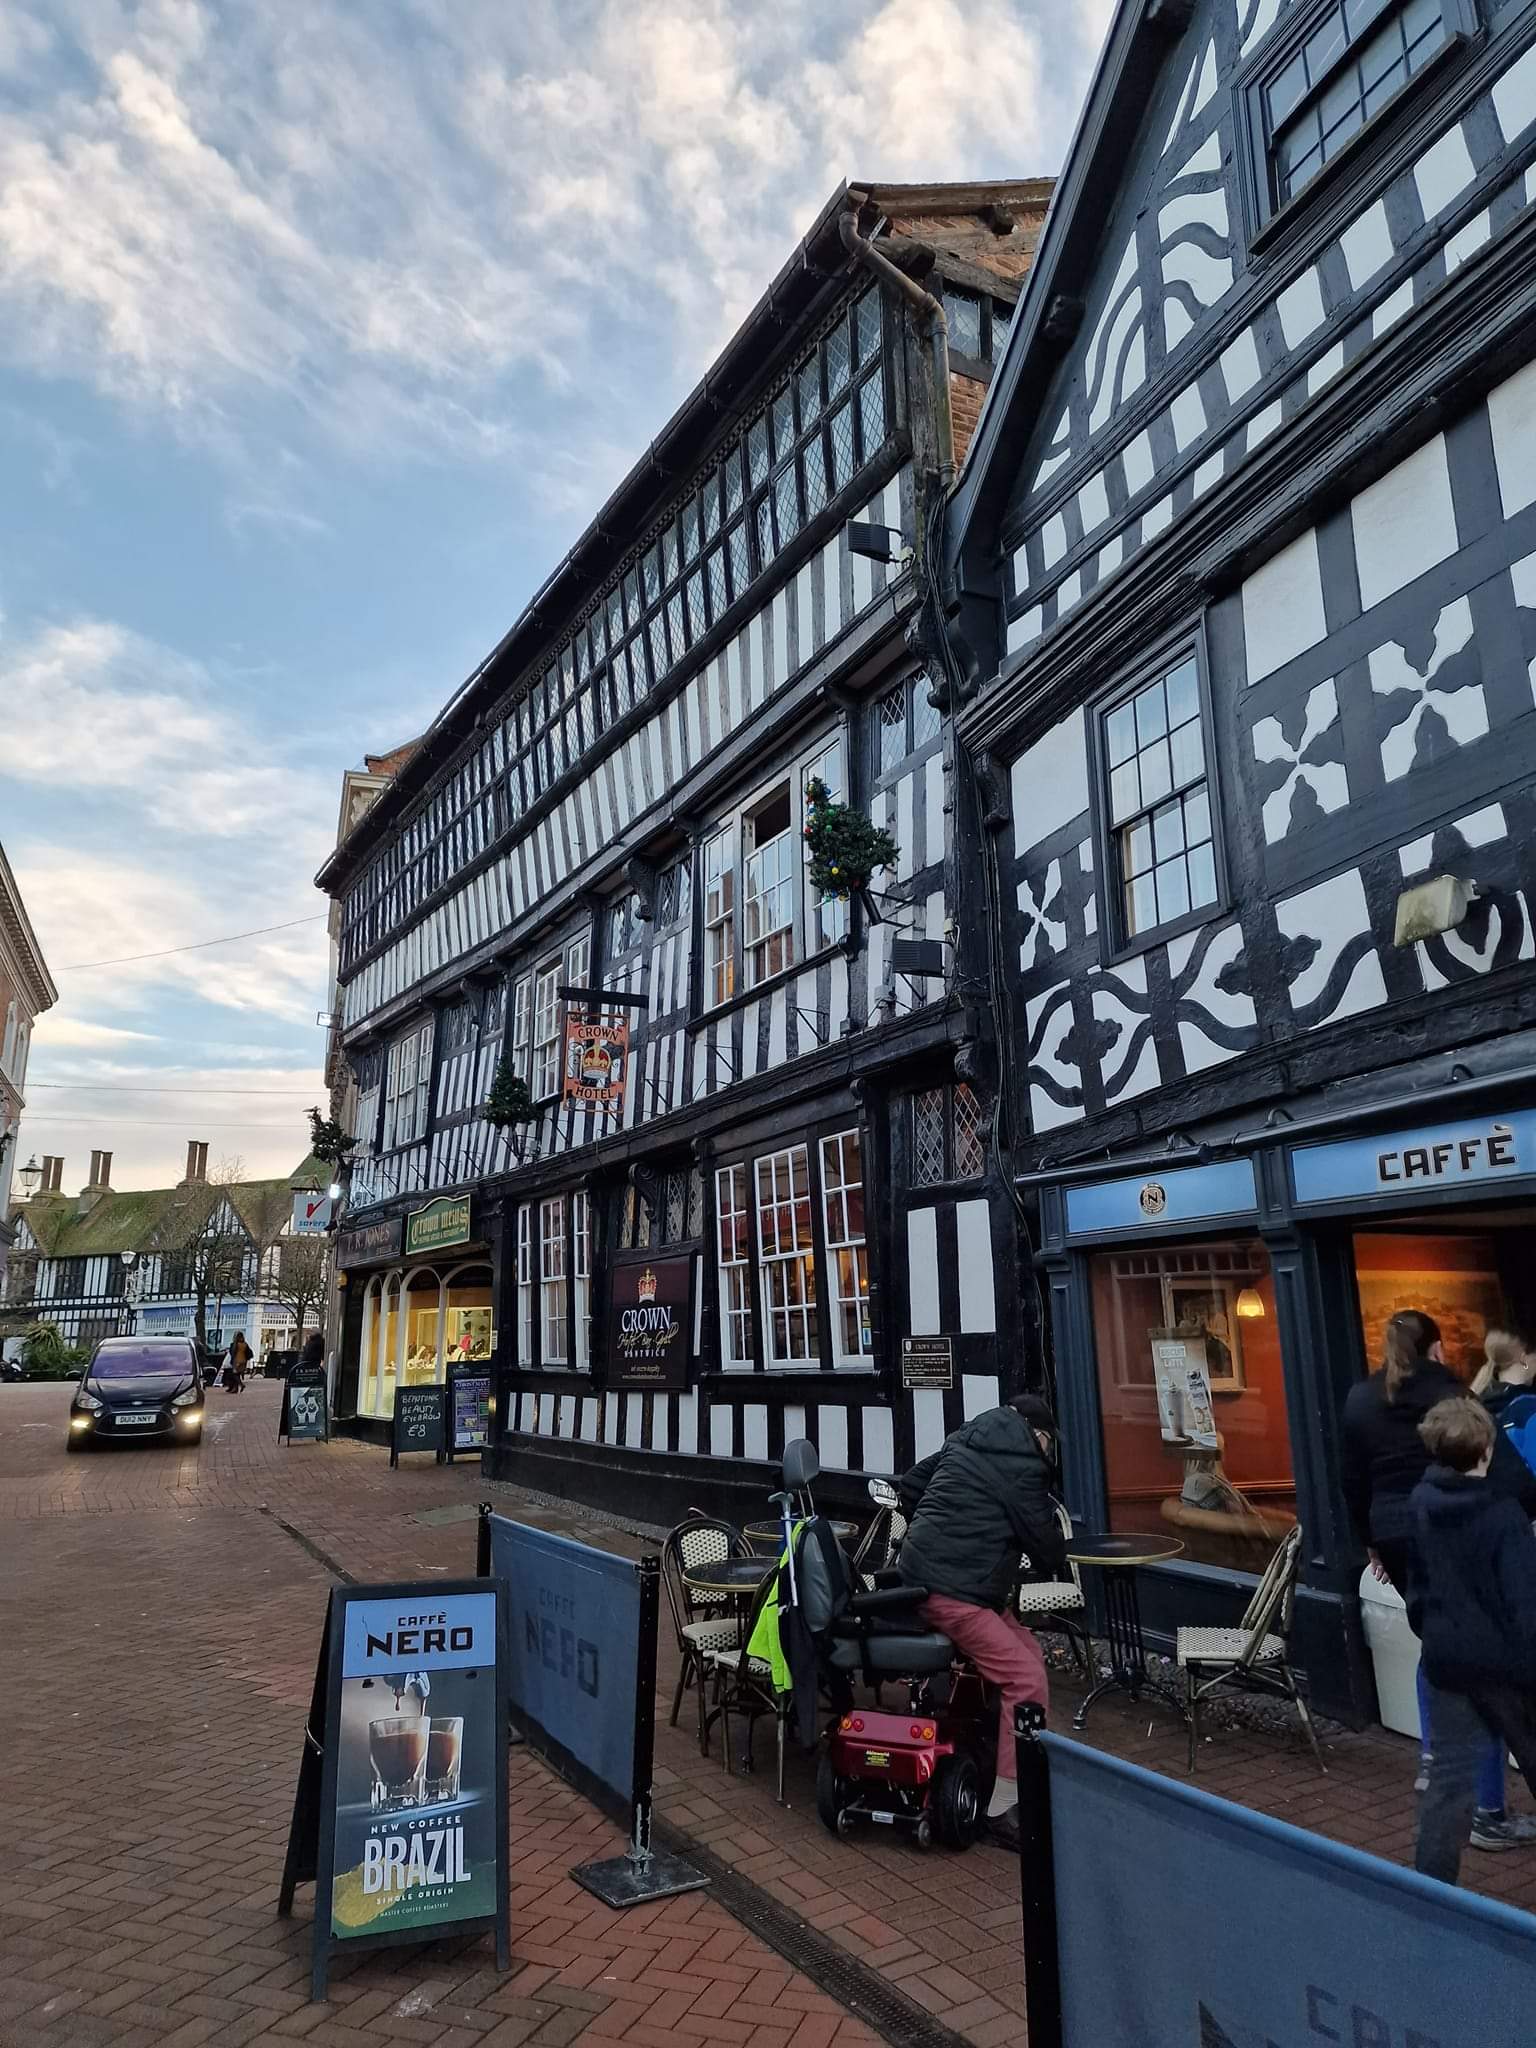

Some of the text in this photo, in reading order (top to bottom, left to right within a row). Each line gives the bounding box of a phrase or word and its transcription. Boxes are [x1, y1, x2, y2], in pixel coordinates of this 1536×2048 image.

[578, 1026, 619, 1041] CROWN
[575, 1087, 614, 1099] HOTEL
[1379, 1124, 1516, 1181] CAFFÈ
[365, 1222, 390, 1248] JONES
[621, 1306, 672, 1332] CROWN
[624, 1348, 665, 1358] NANTWICH
[401, 1404, 433, 1415] BEAUTY
[403, 1412, 441, 1423] EYEBROW
[398, 1611, 447, 1627] CAFFÈ
[366, 1626, 474, 1658] NERO
[525, 1610, 599, 1699] NERO
[371, 1815, 461, 1834] NEW COFFEE
[363, 1826, 472, 1895] BRAZIL
[376, 1887, 454, 1905] SINGLE ORIGIN
[380, 1902, 449, 1917] MASTER COFFEE ROASTERS
